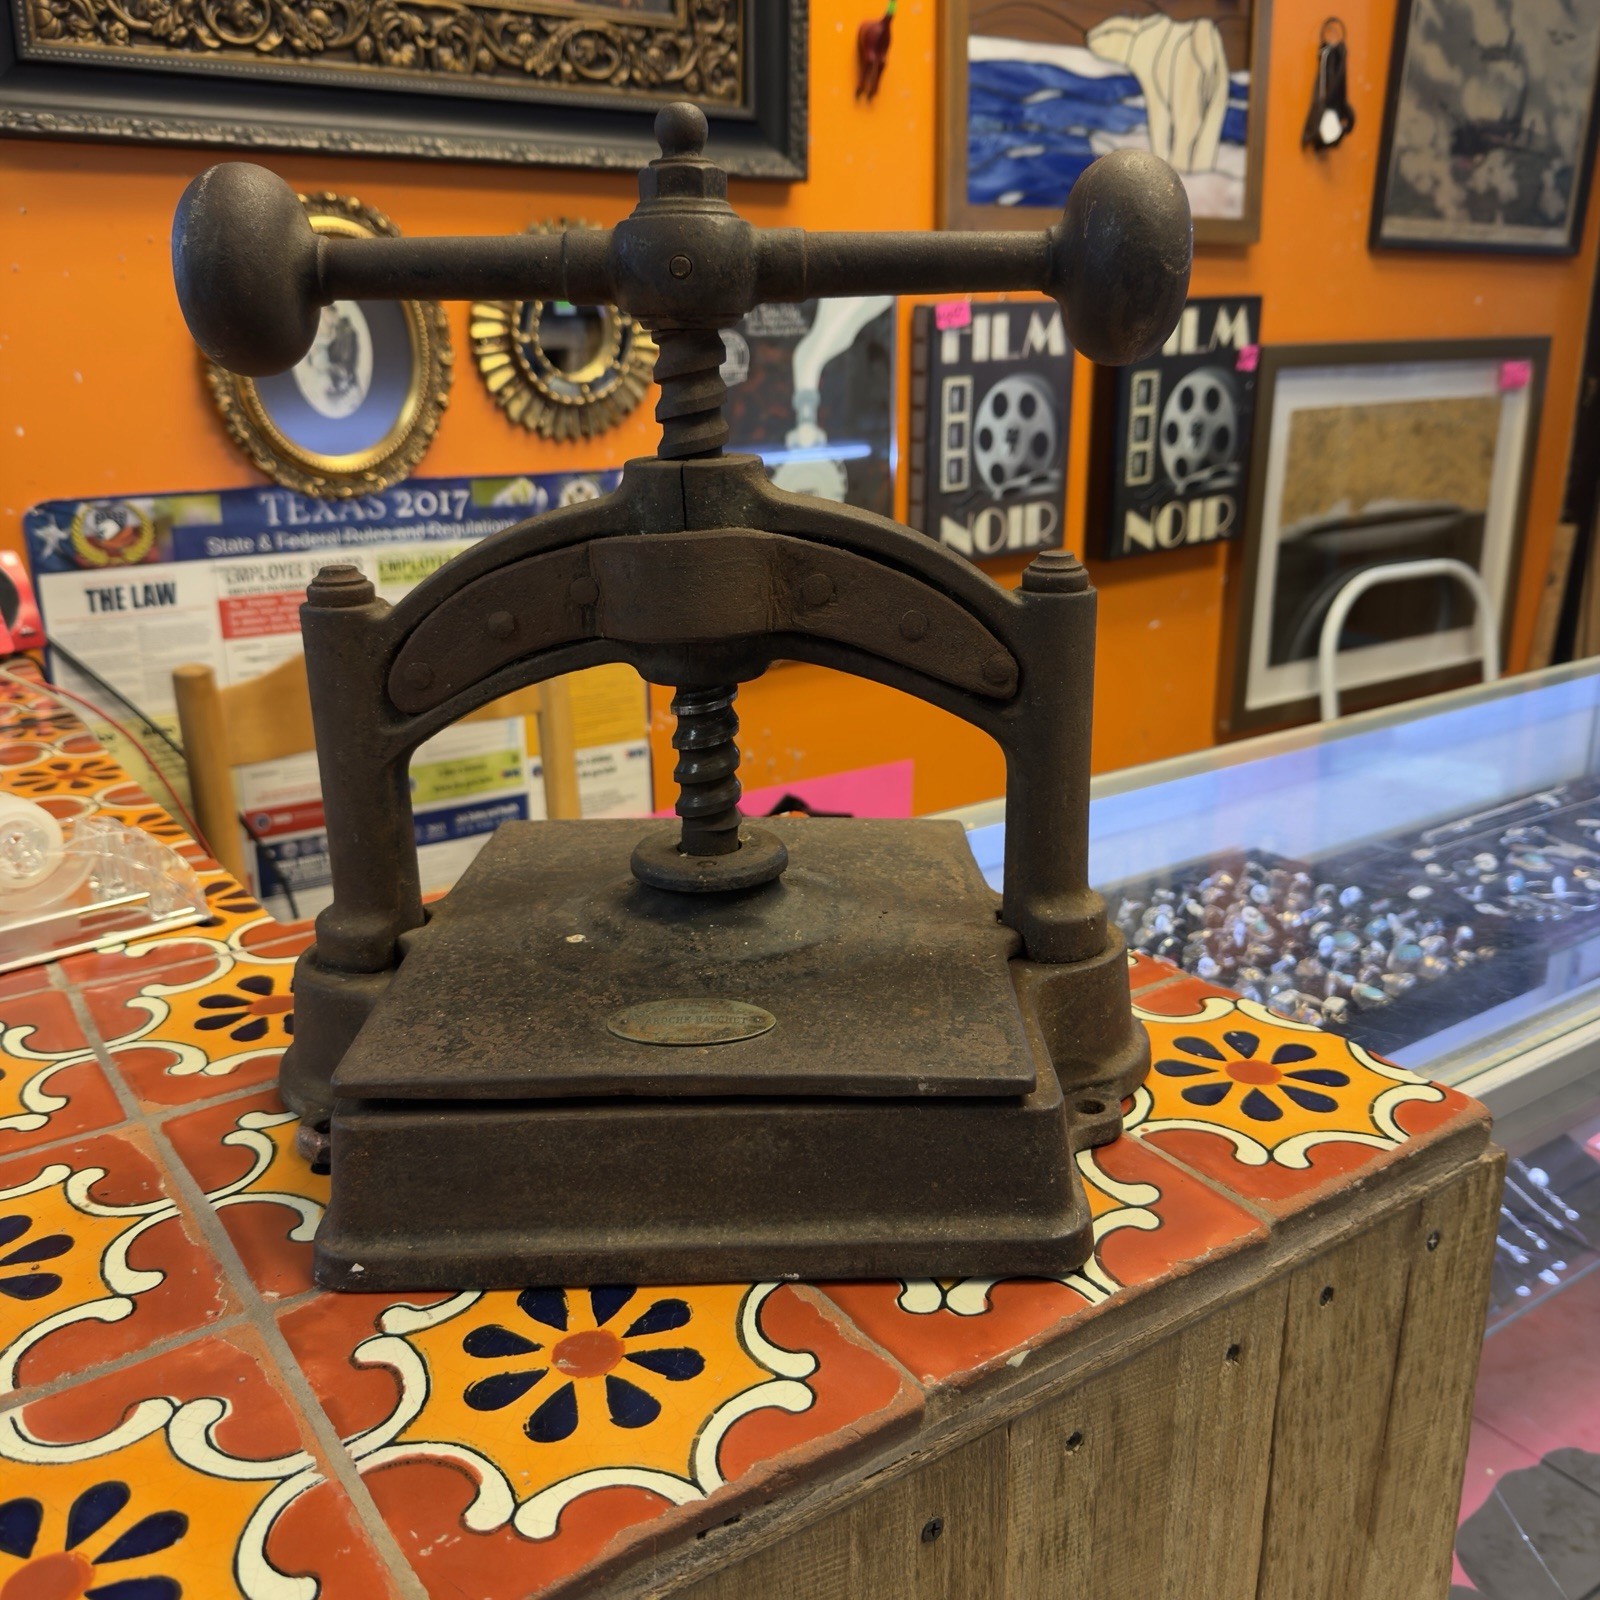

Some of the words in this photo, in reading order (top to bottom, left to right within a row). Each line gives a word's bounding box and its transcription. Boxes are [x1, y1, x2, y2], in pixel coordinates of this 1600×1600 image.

[258, 490, 386, 526] TEXAS
[396, 488, 470, 521] 2017
[1123, 494, 1236, 551] NOIR
[205, 535, 254, 556] State
[257, 533, 272, 552] &
[274, 527, 340, 550] Federal
[940, 500, 1058, 556] NOIR
[85, 585, 125, 613] THE
[130, 582, 177, 609] LAW
